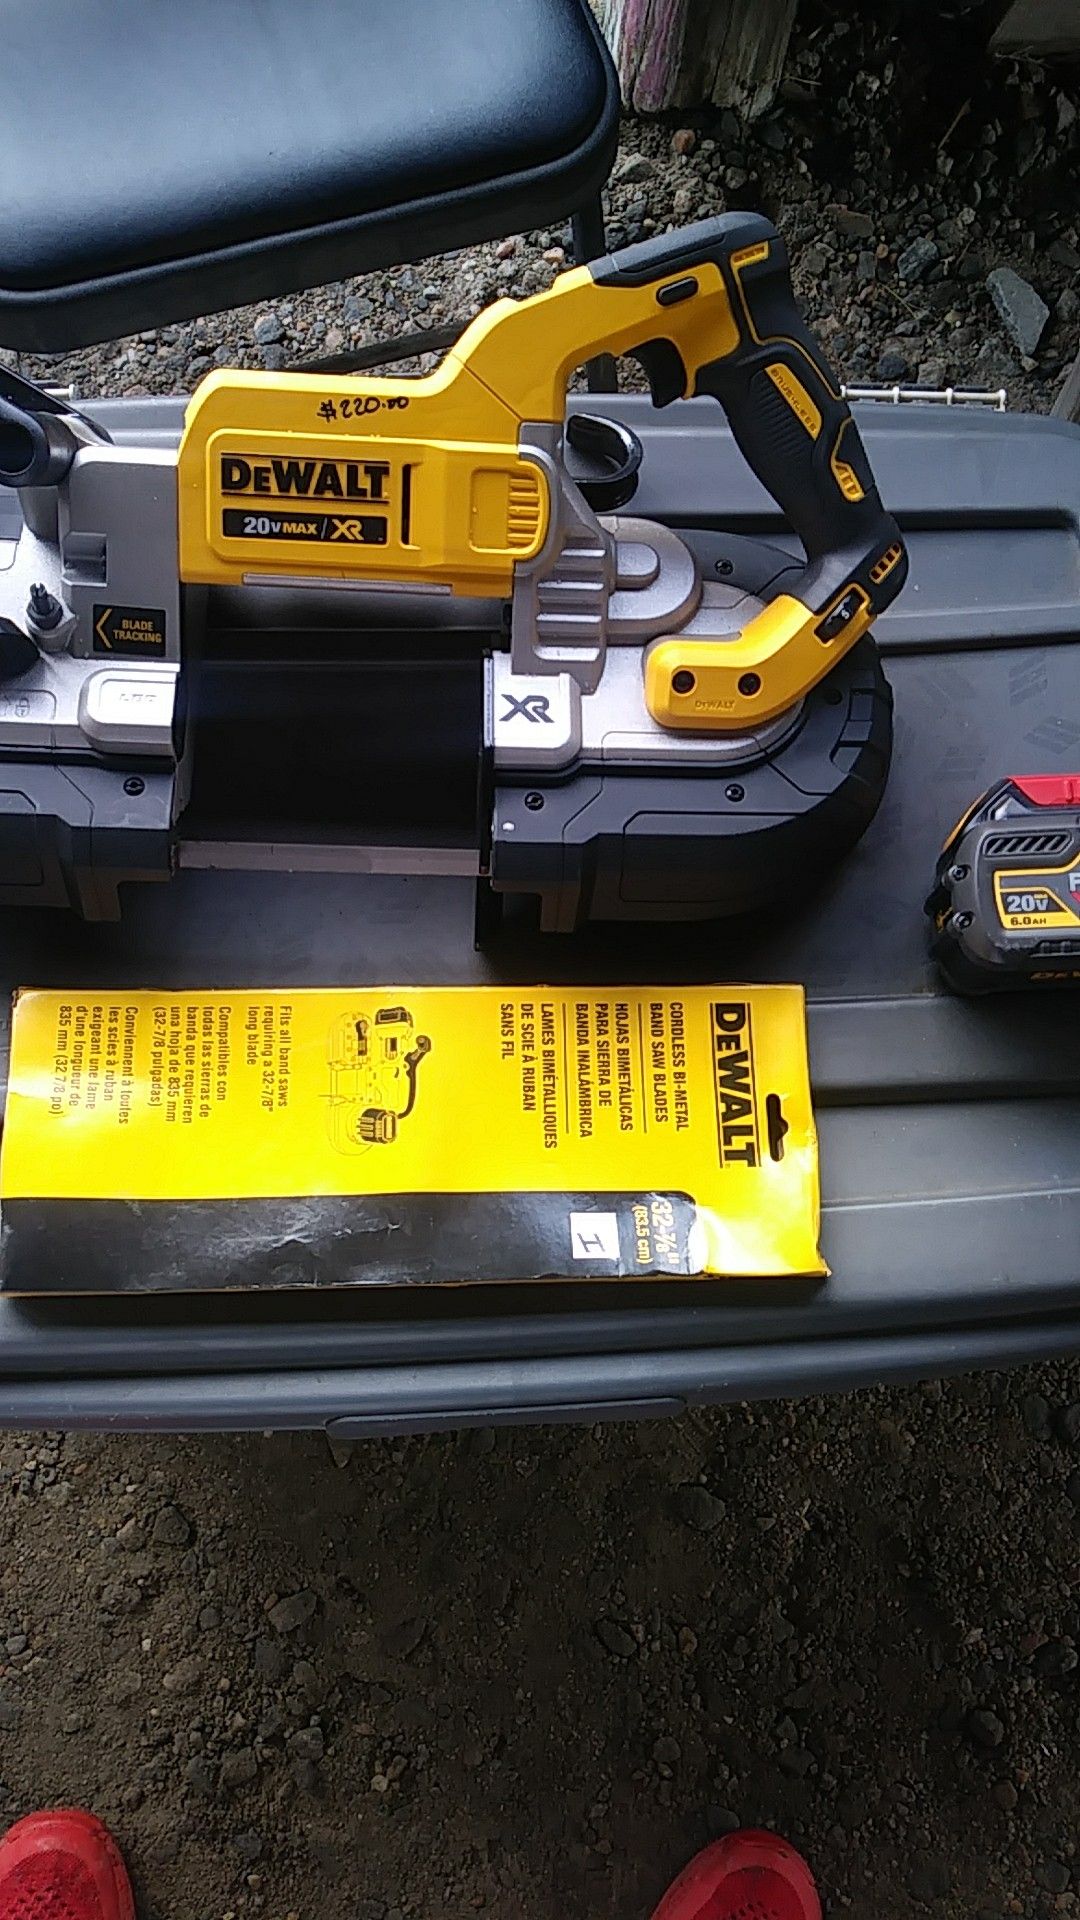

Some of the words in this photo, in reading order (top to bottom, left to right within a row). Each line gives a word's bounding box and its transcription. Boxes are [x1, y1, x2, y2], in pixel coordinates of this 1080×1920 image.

[316, 396, 409, 423] $220.00
[331, 519, 363, 541] XR
[112, 629, 162, 643] TRACKING
[122, 619, 153, 631] BLADE
[499, 693, 556, 723] XR
[59, 1005, 72, 1026] 835
[74, 1006, 88, 1037] d'une
[108, 1006, 121, 1023] les
[170, 1006, 180, 1027] una
[186, 1006, 198, 1041] banda
[202, 1006, 214, 1037] todas
[245, 1006, 259, 1030] long
[279, 1006, 292, 1026] Fits
[501, 1003, 514, 1036] SANS
[521, 1003, 535, 1019] DE
[541, 1003, 555, 1045] LAMES
[576, 1003, 590, 1046] BANDA
[596, 1003, 610, 1036] PARA
[615, 1003, 630, 1044] HOJAS
[650, 1003, 665, 1037] BAND
[56, 1030, 68, 1051] mm
[88, 1006, 104, 1055] exigeant
[152, 1006, 166, 1047] (32-7/8
[261, 1006, 275, 1056] requiring
[279, 1030, 291, 1043] all
[522, 1023, 535, 1051] SCIE
[670, 1002, 685, 1067] CORDLESS
[107, 1027, 119, 1056] scies
[122, 1006, 138, 1077] Conviennent
[167, 1031, 180, 1055] hoja
[183, 1044, 195, 1064] que
[202, 1040, 214, 1057] las
[216, 1006, 231, 1077] Compatibles
[247, 1034, 258, 1065] blade
[502, 1041, 515, 1059] FIL
[652, 1042, 666, 1069] SAW
[54, 1055, 68, 1073] (32
[70, 1040, 86, 1090] longueur
[88, 1058, 100, 1078] une
[168, 1060, 180, 1073] de
[278, 1047, 290, 1074] band
[522, 1055, 538, 1063] À
[597, 1040, 611, 1086] SIERRA
[104, 1070, 117, 1101] ruban
[148, 1051, 164, 1107] pulgadas)
[168, 1077, 180, 1097] 835
[200, 1061, 212, 1100] sierras
[217, 1081, 226, 1100] con
[278, 1078, 289, 1107] saws
[523, 1068, 535, 1111] RUBAN
[618, 1048, 634, 1131] BIMETÁLICAS
[49, 1096, 63, 1115] po)
[69, 1093, 82, 1106] de
[118, 1090, 133, 1124] toutes
[180, 1069, 195, 1123] requieren
[542, 1050, 558, 1148] BIMÉTALLIQUES
[577, 1050, 594, 1138] INALÁMBRICA
[599, 1091, 612, 1106] DE
[654, 1074, 668, 1122] BLADES
[674, 1072, 688, 1131] BI-METAL
[166, 1101, 176, 1122] mm
[199, 1104, 211, 1117] de
[632, 1205, 649, 1236] (83.5
[636, 1240, 652, 1264] cm)
